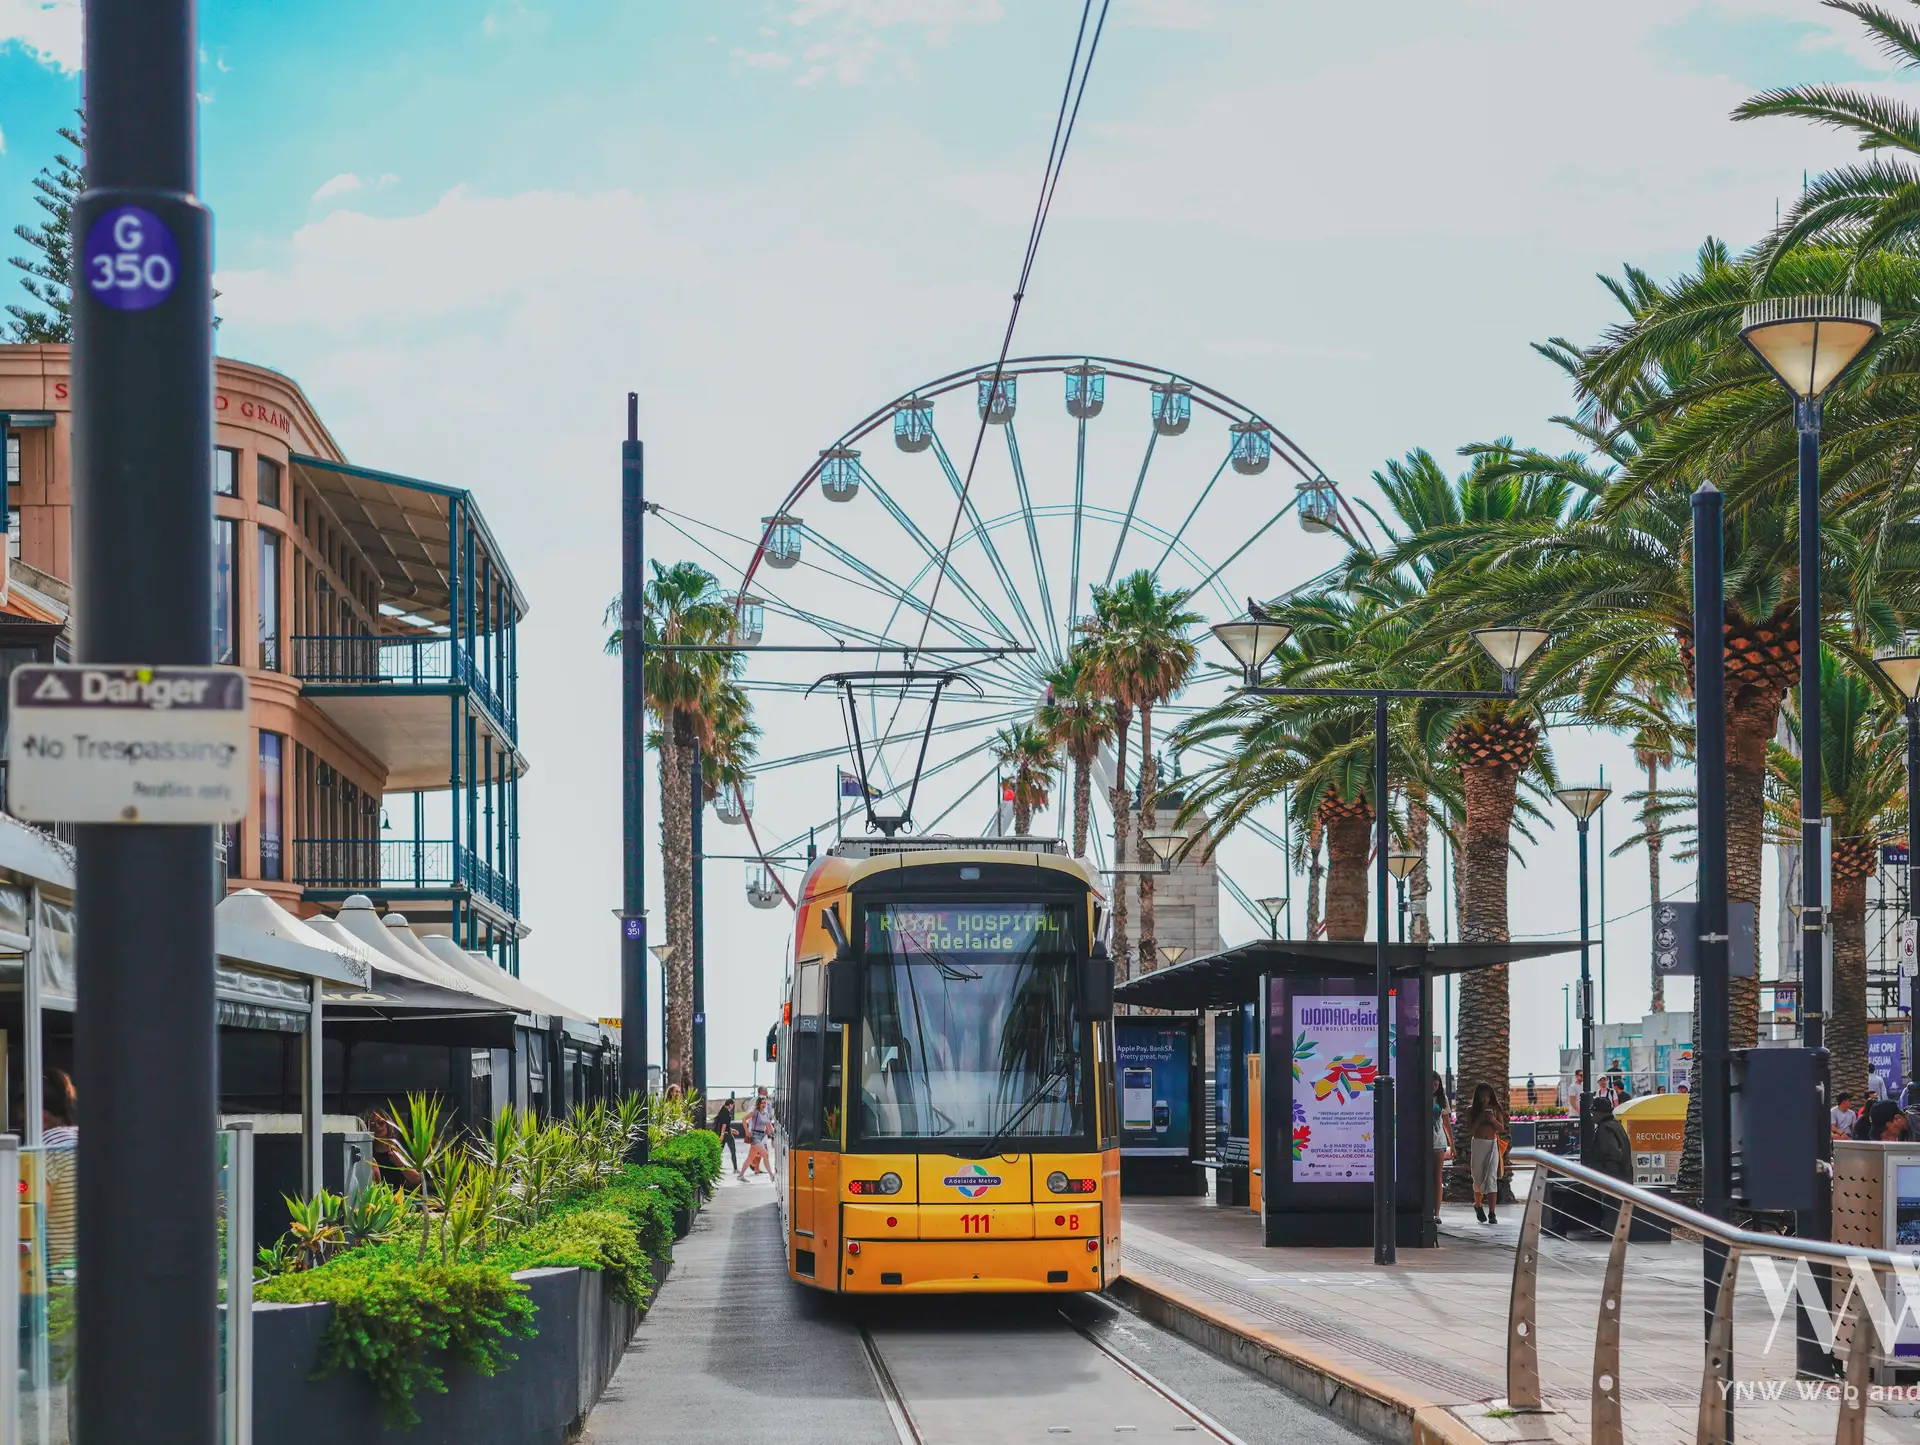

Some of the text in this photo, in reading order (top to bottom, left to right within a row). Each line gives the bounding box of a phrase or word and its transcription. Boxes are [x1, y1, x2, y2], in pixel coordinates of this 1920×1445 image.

[114, 214, 143, 250] G
[91, 253, 171, 290] 350
[241, 401, 290, 434] GRAND
[80, 671, 210, 709] Danger
[26, 735, 64, 760] No
[73, 735, 233, 767] Trespassing
[880, 914, 1060, 931] ROYAL HOSPITAL
[926, 933, 1013, 949] Adelaide
[1301, 1008, 1379, 1025] WOMADelaid
[1117, 1045, 1135, 1053] Apple
[1136, 1045, 1149, 1053] Pay.
[1120, 1053, 1172, 1061] Pretty great, hey?
[1636, 1132, 1681, 1140] RECYCLING
[960, 1214, 989, 1234] 111
[1069, 1215, 1079, 1231] B
